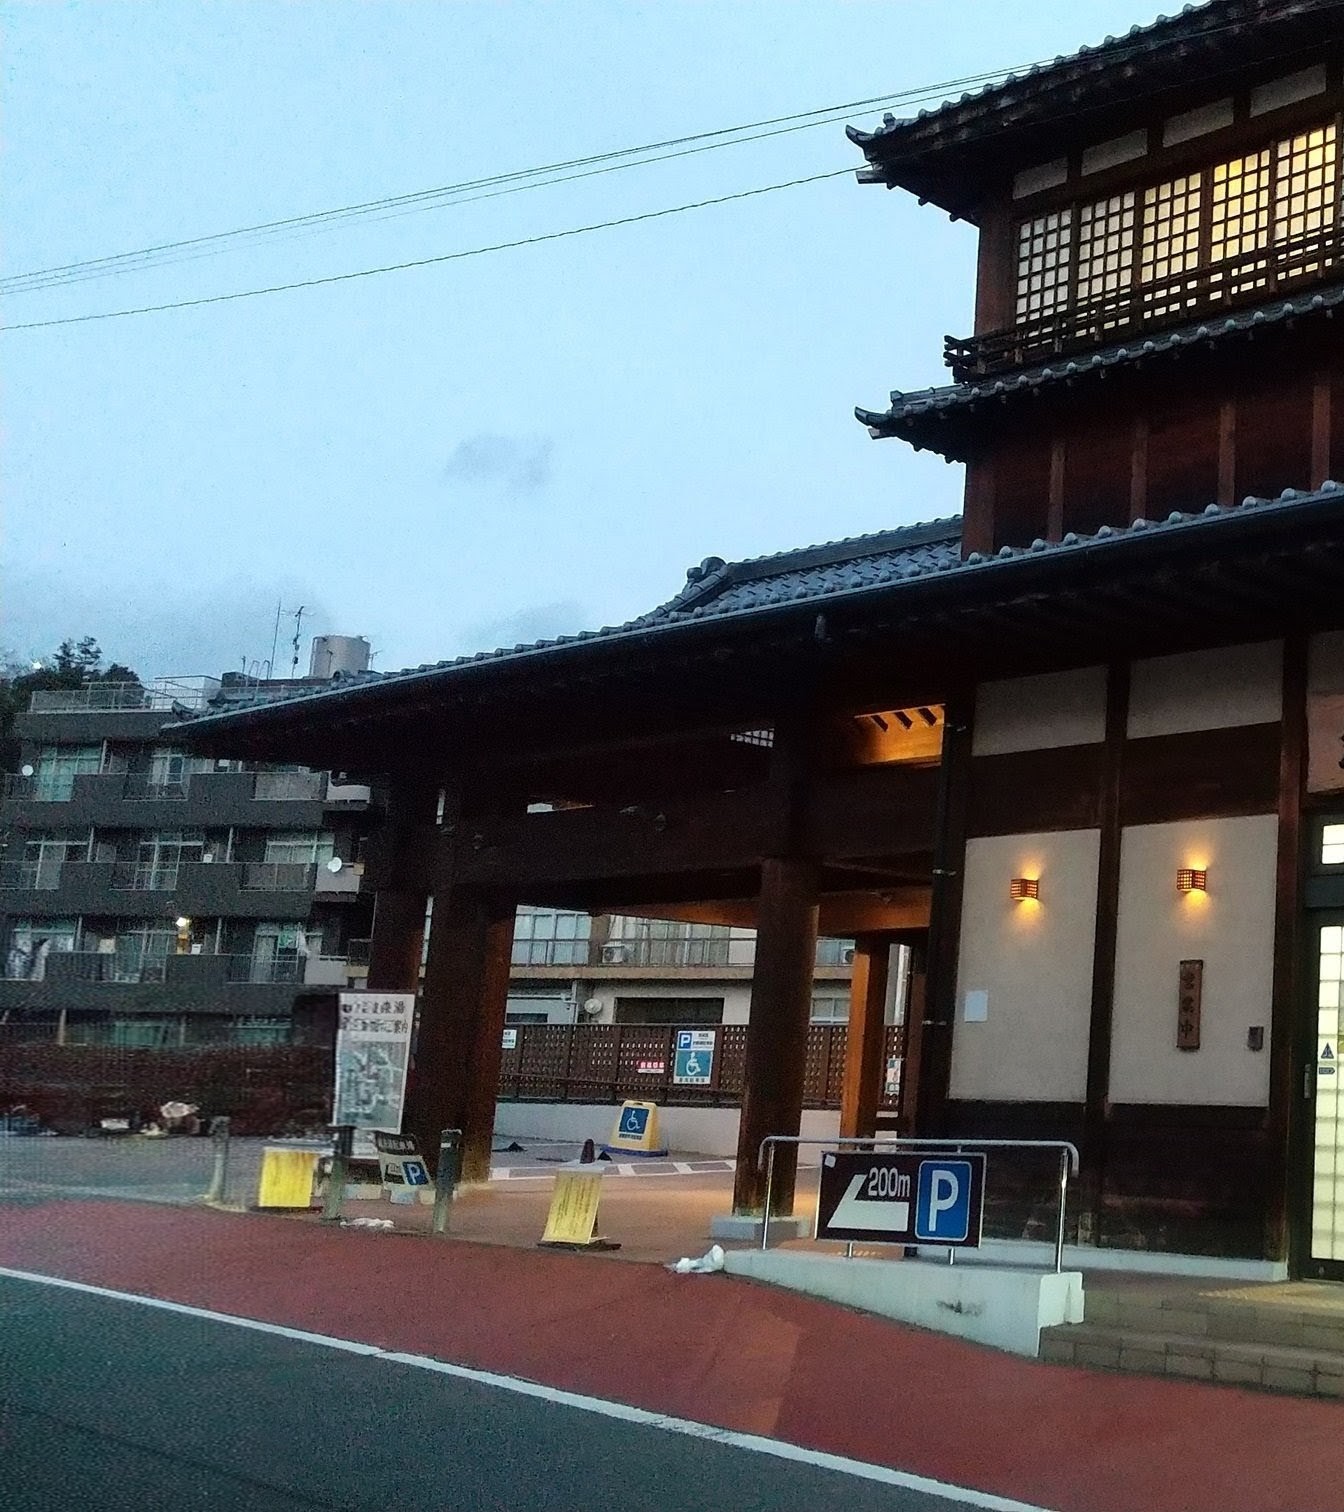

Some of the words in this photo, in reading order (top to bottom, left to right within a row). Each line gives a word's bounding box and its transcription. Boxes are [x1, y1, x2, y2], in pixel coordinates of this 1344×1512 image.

[680, 1034, 691, 1048] P
[407, 1163, 421, 1184] P
[867, 1167, 911, 1198] 200m
[928, 1169, 960, 1232] P
